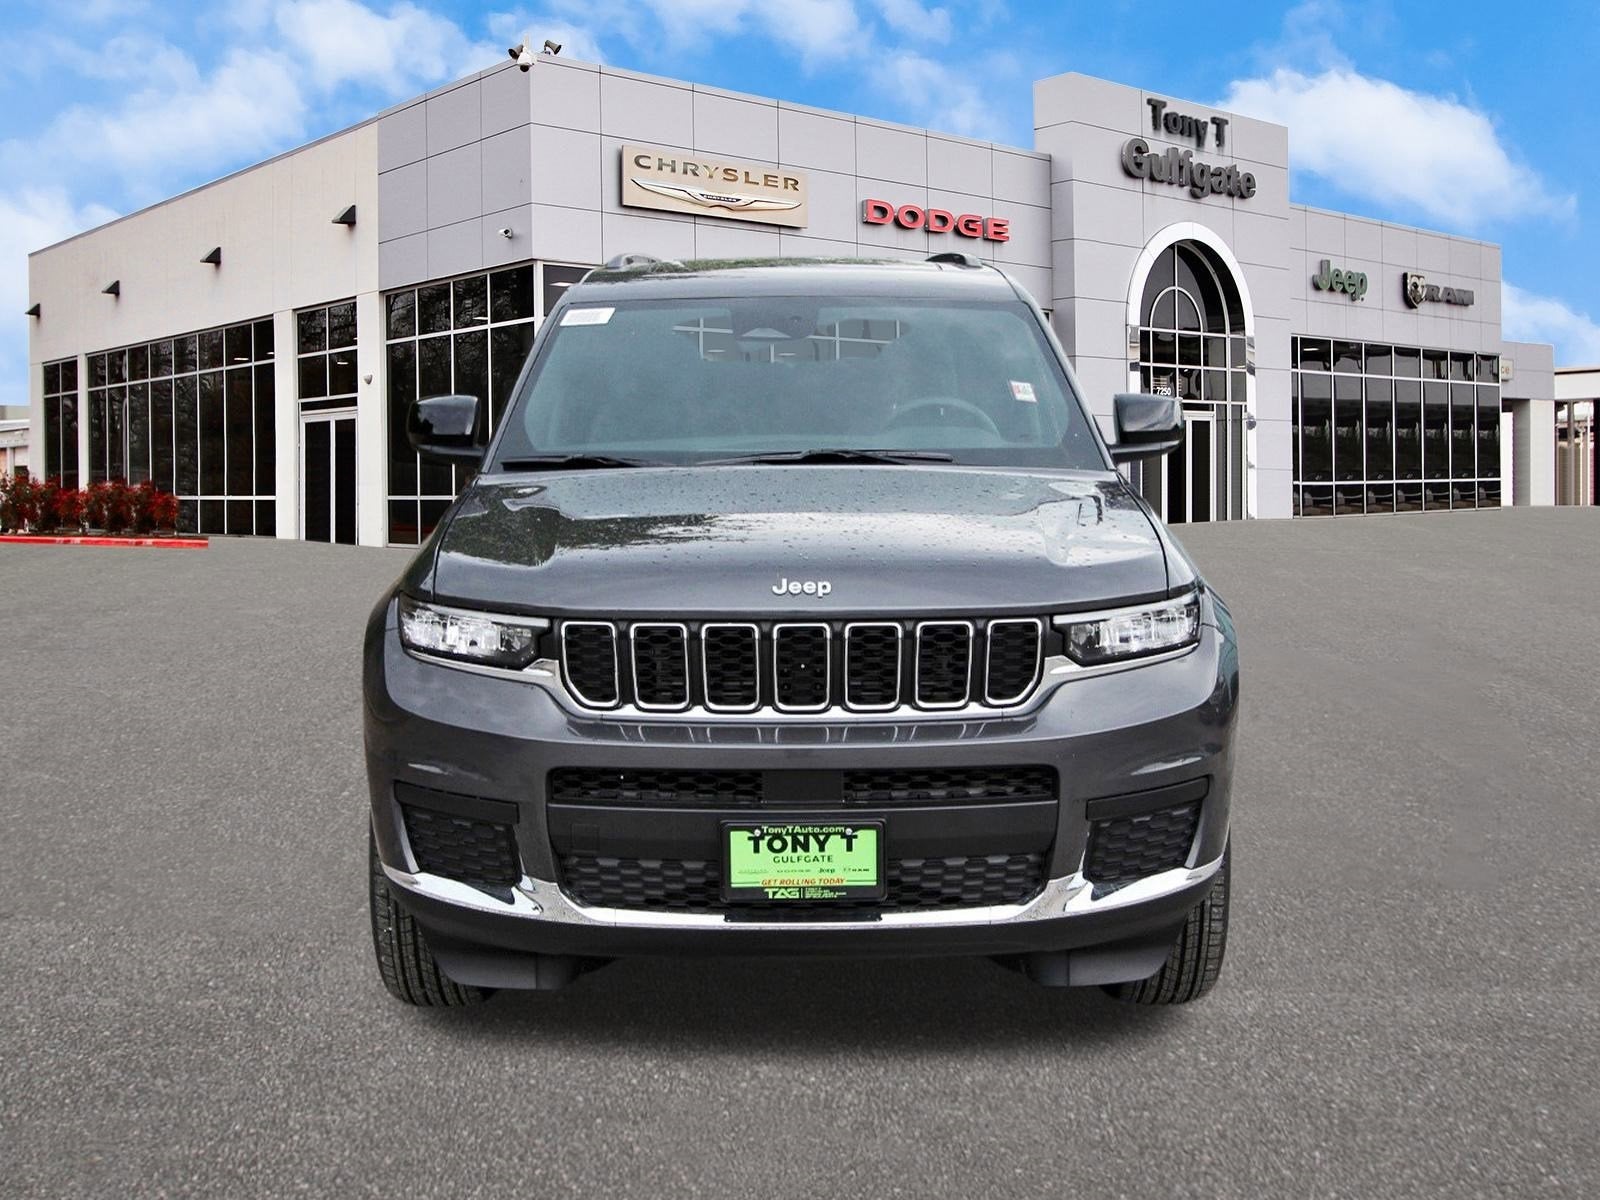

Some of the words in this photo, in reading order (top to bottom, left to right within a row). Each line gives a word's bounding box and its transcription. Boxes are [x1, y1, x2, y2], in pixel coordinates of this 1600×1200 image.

[1146, 98, 1208, 147] Tony
[1210, 117, 1229, 147] T
[634, 154, 801, 191] CHRYSLER
[1122, 138, 1256, 198] Gulfgate
[863, 199, 1010, 242] DODGE
[1312, 259, 1367, 302] Jeep
[1425, 284, 1474, 306] RAM
[1156, 387, 1171, 395] 7250
[772, 578, 831, 598] Jeep
[761, 826, 845, 835] TonyTAuto.com
[748, 835, 829, 853] TONY
[840, 835, 858, 852] T
[773, 855, 833, 863] GULFGATE
[765, 888, 799, 898] TAG
